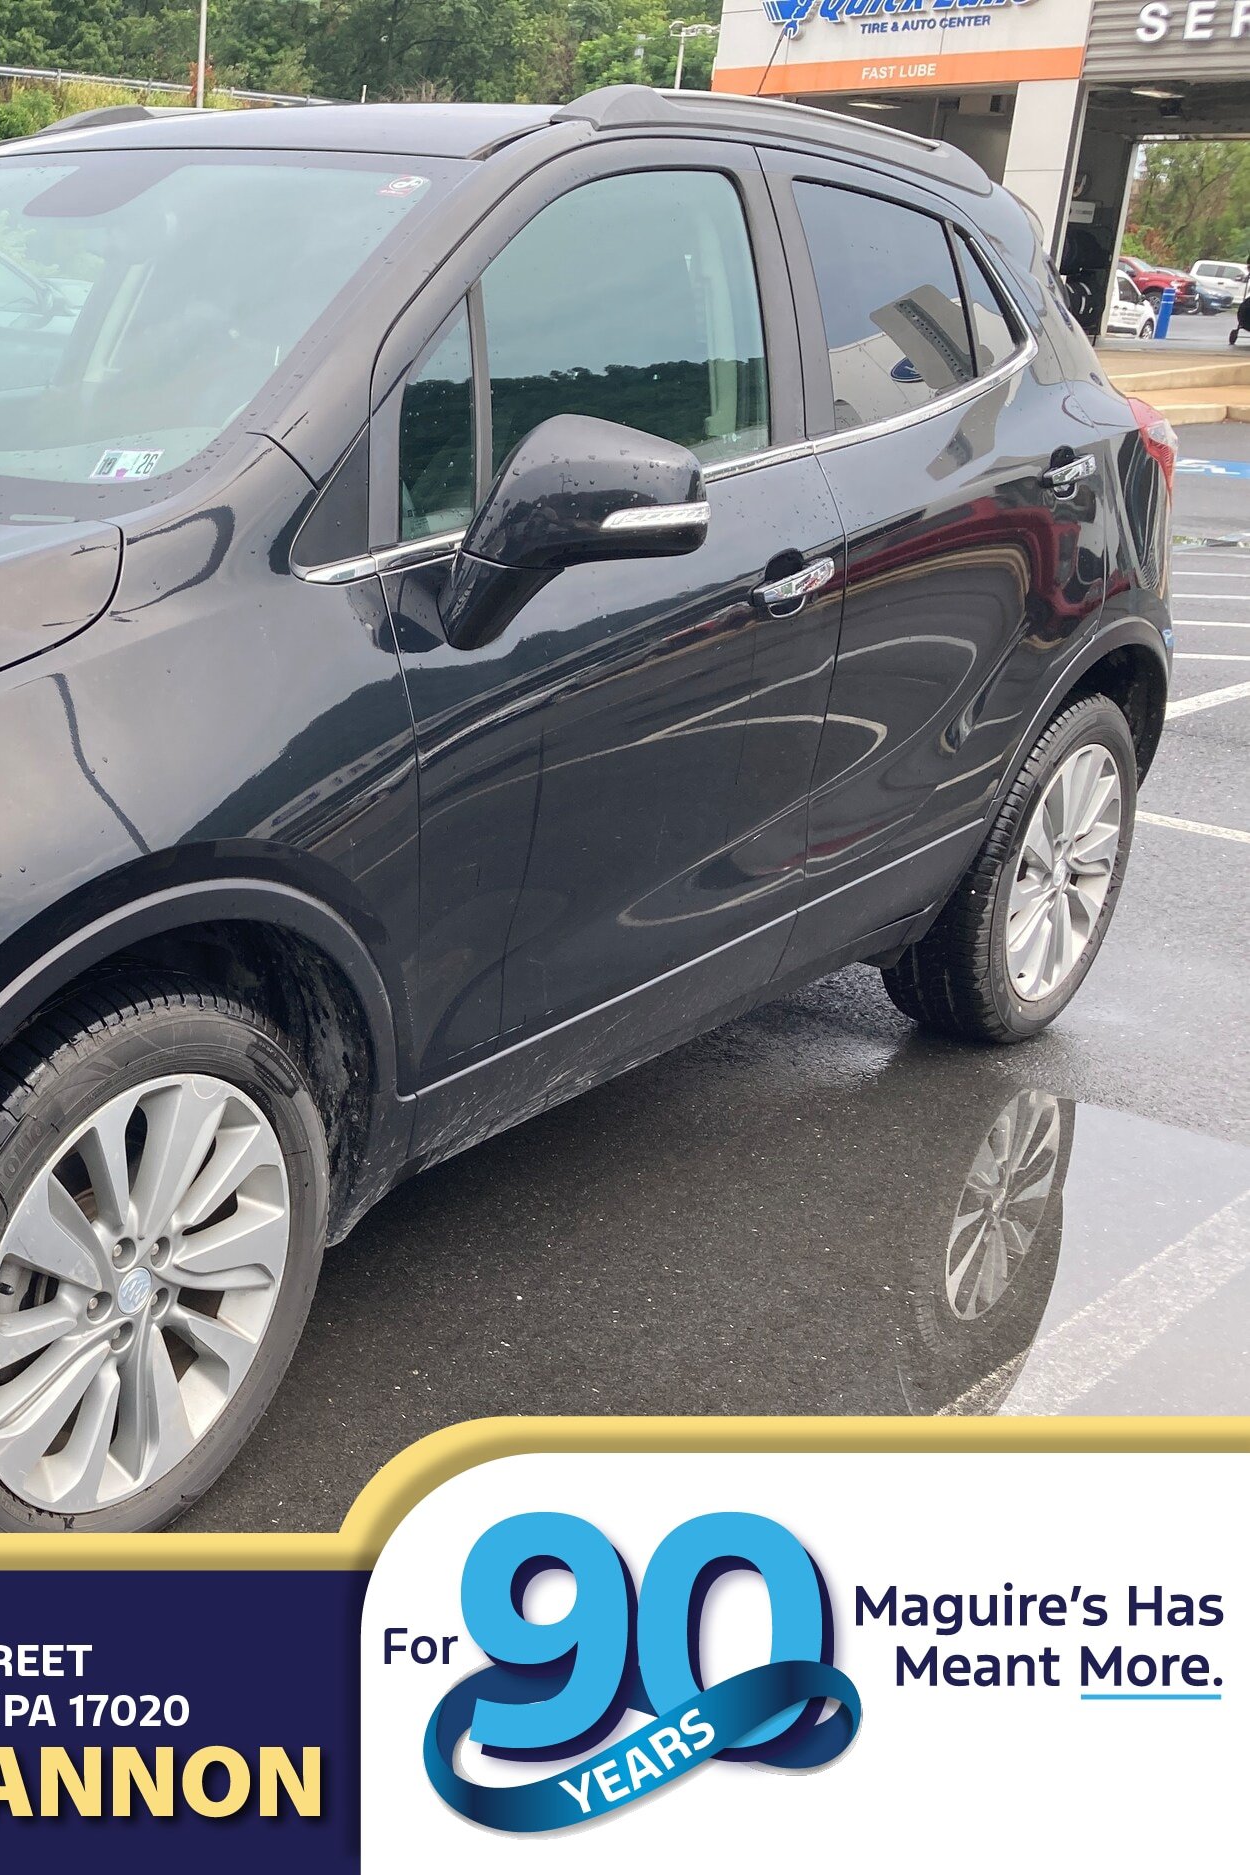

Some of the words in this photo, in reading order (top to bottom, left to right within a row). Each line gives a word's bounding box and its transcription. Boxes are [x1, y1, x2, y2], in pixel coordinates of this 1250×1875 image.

[860, 22, 888, 34] TIRE
[890, 21, 899, 32] &
[901, 18, 937, 31] AUTO
[939, 14, 991, 29] CENTER
[861, 65, 896, 80] FAST
[899, 63, 937, 78] LUBE
[135, 453, 159, 474] 26
